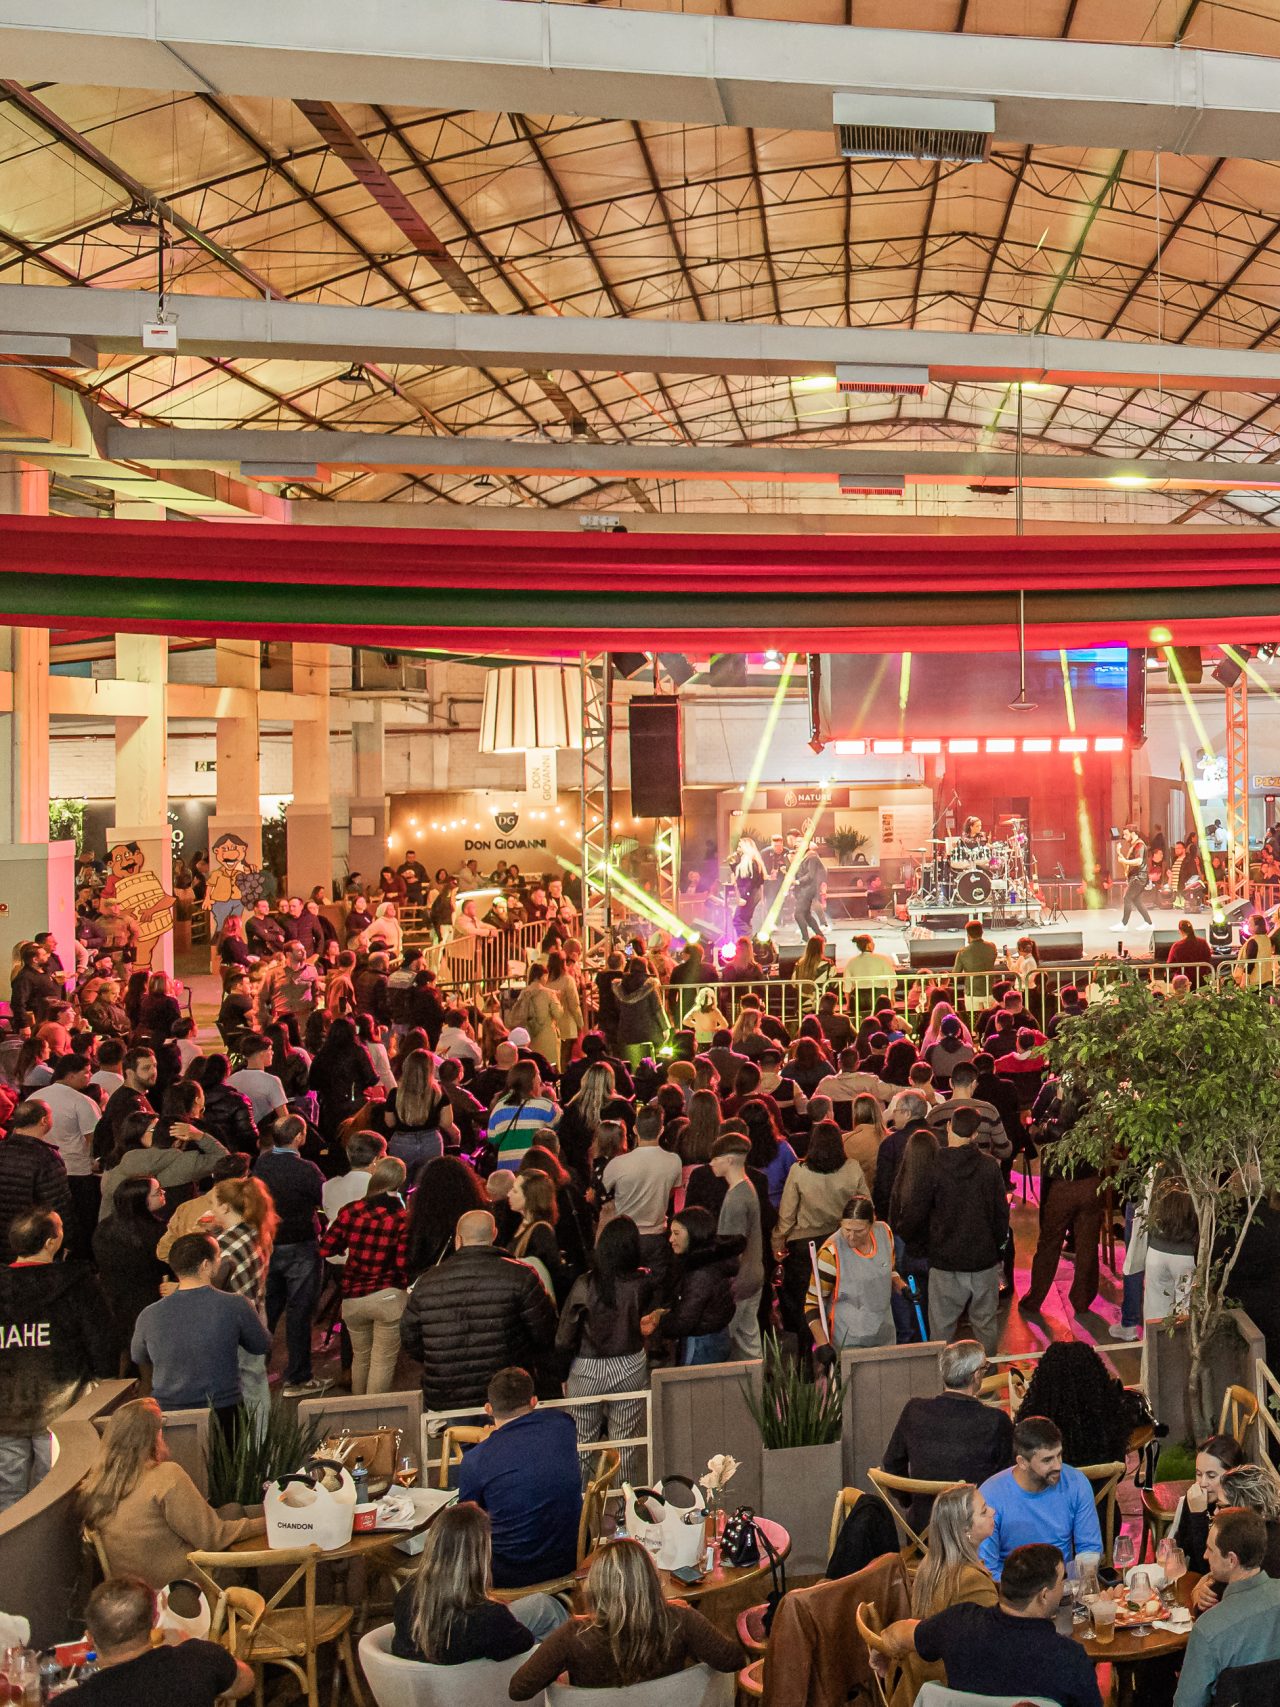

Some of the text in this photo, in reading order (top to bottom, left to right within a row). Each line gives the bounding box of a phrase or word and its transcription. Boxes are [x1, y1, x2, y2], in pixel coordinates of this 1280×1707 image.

[532, 767, 540, 789] DON
[542, 755, 551, 801] GIOVANNI
[498, 816, 516, 825] DG
[464, 838, 547, 851] DON GIOVANNI
[277, 1521, 314, 1530] CHANDON
